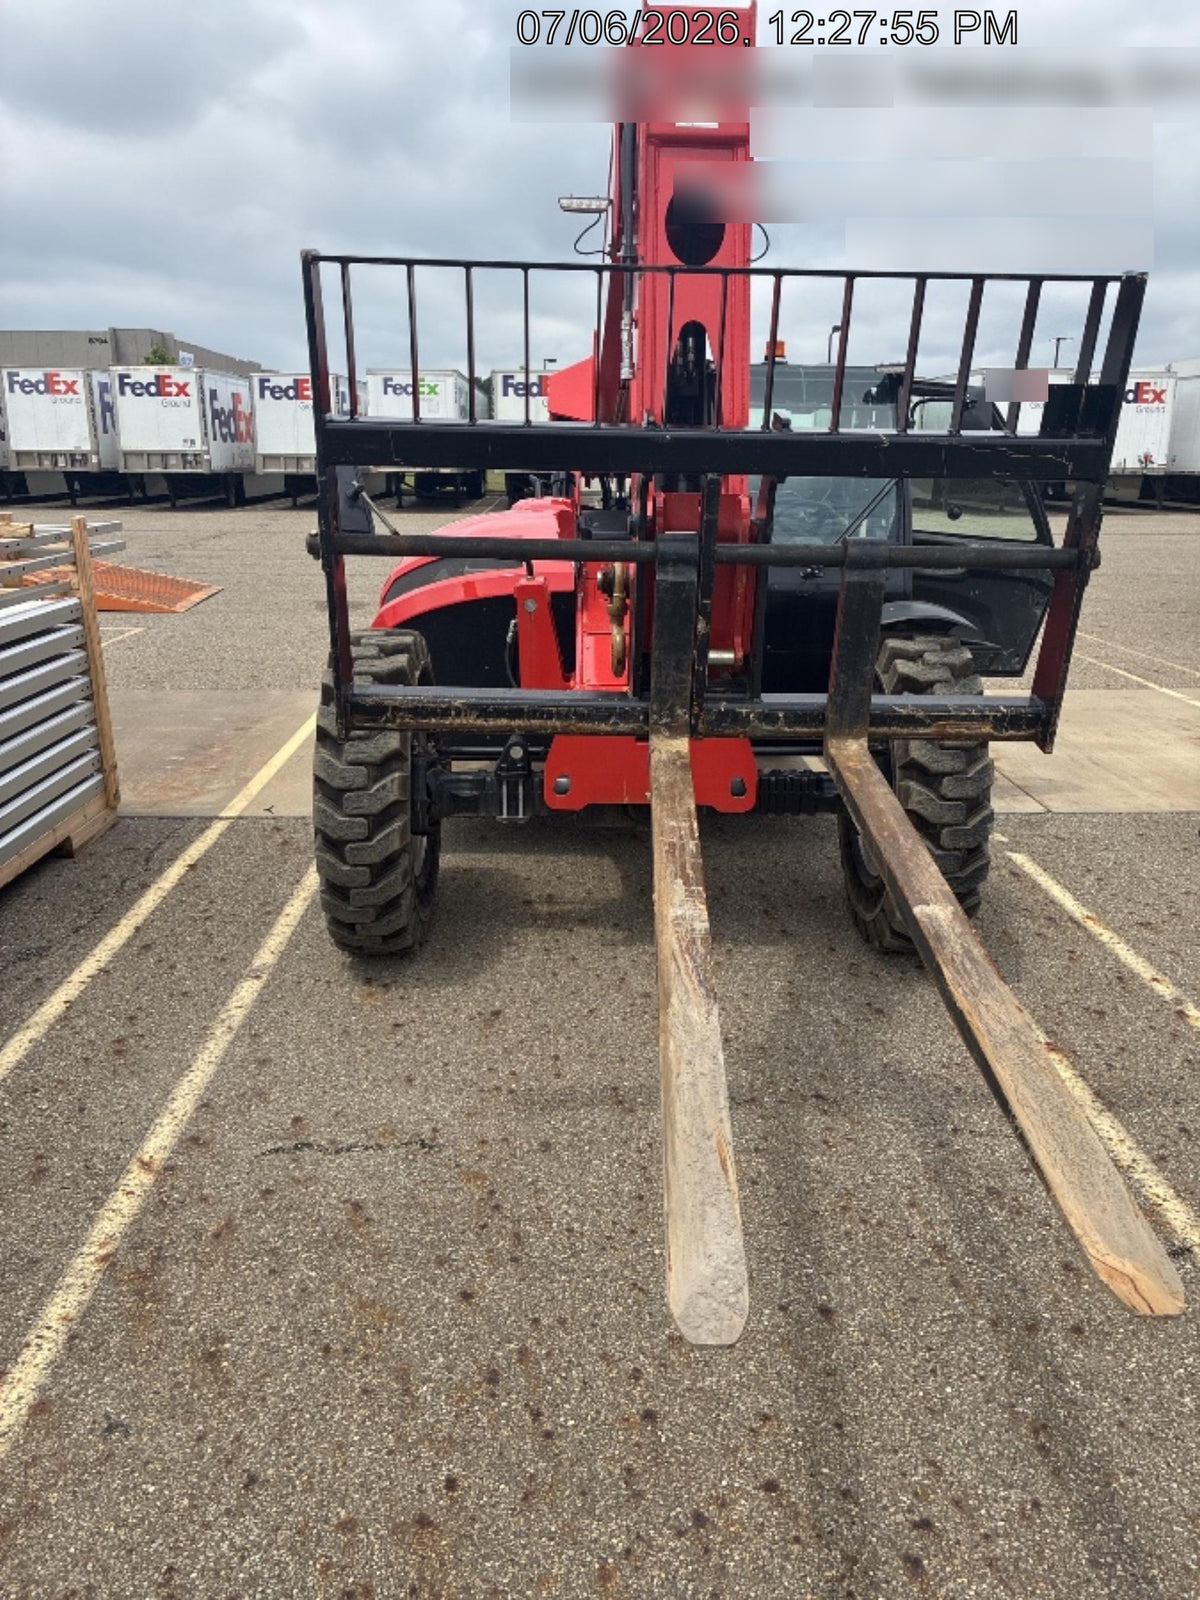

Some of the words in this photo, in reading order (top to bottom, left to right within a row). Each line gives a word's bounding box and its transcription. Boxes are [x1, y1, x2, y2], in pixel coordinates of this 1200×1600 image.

[7, 371, 79, 395] FedEx
[118, 373, 190, 397] FedEx
[259, 378, 311, 400] FedE
[1123, 381, 1167, 404] dEx
[210, 388, 254, 443] FedEx
